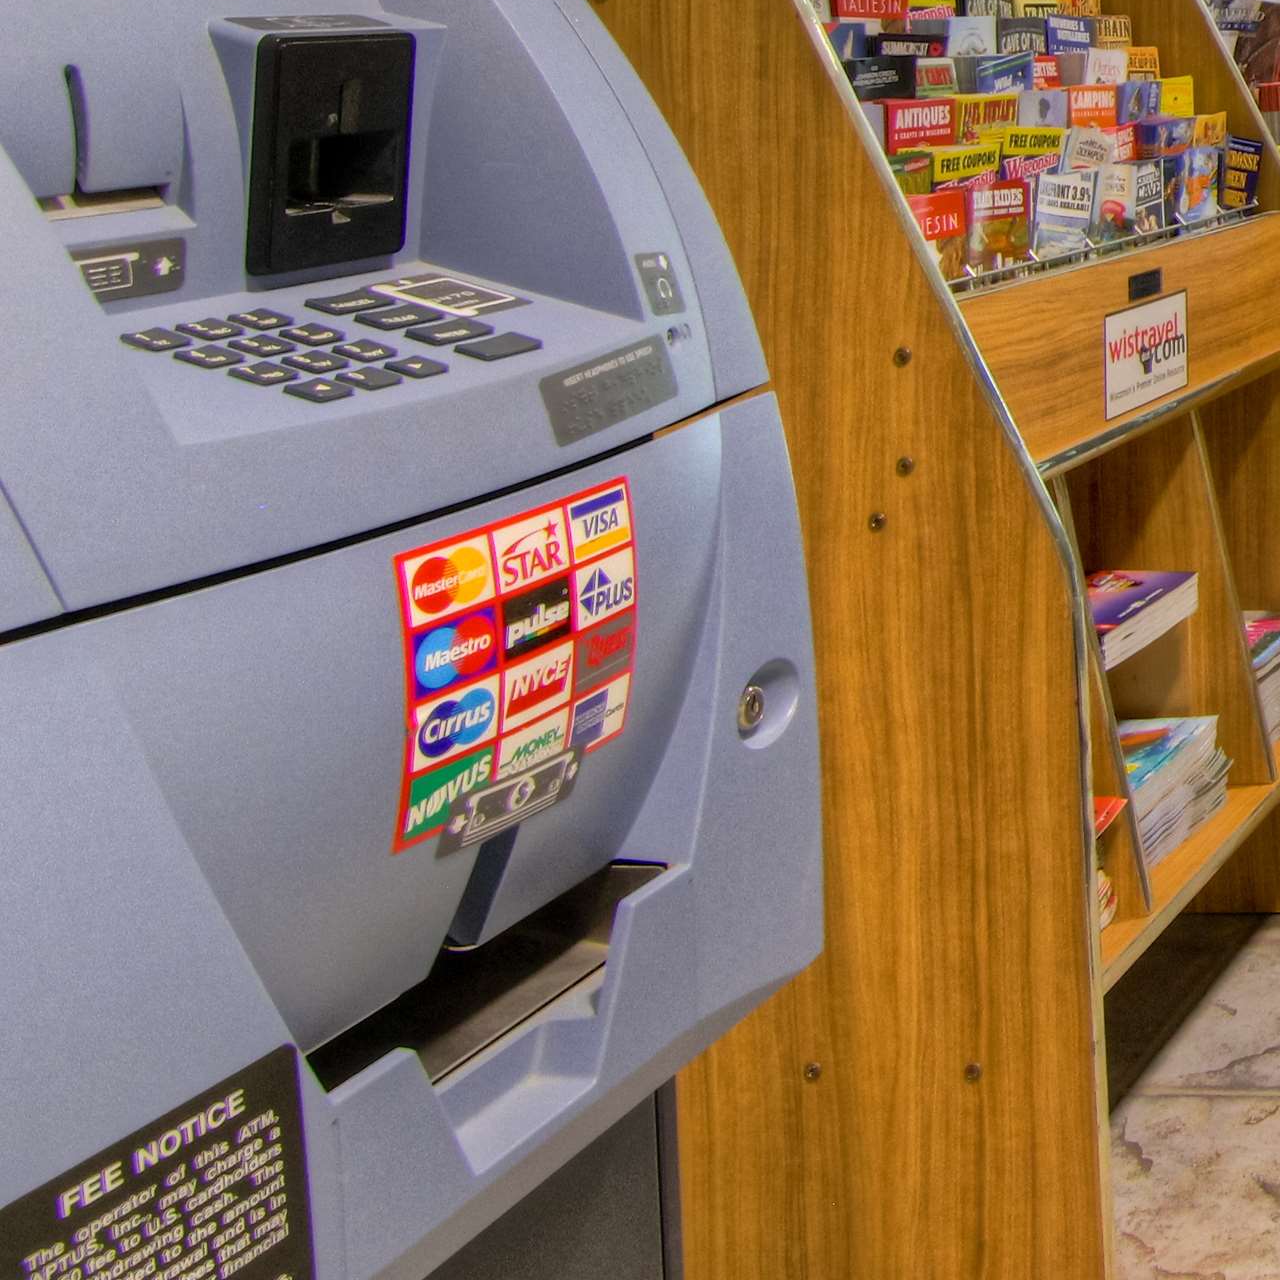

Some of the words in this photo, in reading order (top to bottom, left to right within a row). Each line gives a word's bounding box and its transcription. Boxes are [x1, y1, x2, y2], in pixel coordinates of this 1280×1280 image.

[1002, 34, 1021, 53] CAVE
[1021, 33, 1032, 51] OF
[1032, 32, 1045, 52] THE
[896, 105, 950, 128] ANTIQUES
[1072, 90, 1115, 109] CAMPING
[941, 158, 960, 174] FREE
[962, 150, 997, 170] COUPONS
[1010, 134, 1027, 148] FREE
[1029, 134, 1060, 148] COUPONS
[1006, 153, 1059, 180] Wisconsin
[921, 214, 959, 236] IESIN
[1109, 312, 1178, 364] wistravel
[582, 506, 619, 539] VISA
[413, 560, 487, 600] MasterCard
[502, 538, 566, 587] STAR
[595, 576, 634, 617] PLUS
[506, 598, 570, 649] pulse
[424, 632, 492, 673] Maestro
[512, 655, 571, 702] NYCE
[425, 699, 493, 743] Cirrus
[512, 725, 563, 761] MONEY
[57, 1161, 124, 1219] FEE
[133, 1088, 246, 1174] NOTICE
[158, 1178, 197, 1211] may
[204, 1137, 263, 1183] charge
[269, 1126, 281, 1142] a
[21, 1241, 65, 1272] The
[73, 1184, 157, 1243] operator
[164, 1163, 187, 1189] of
[193, 1141, 230, 1169] this
[235, 1109, 280, 1144] ATM,
[84, 1248, 116, 1275] fee
[117, 1234, 141, 1255] to
[143, 1207, 182, 1237] U.S.
[183, 1143, 283, 1212] cardholders
[190, 1191, 239, 1227] cash.
[251, 1160, 284, 1186] The
[160, 1244, 182, 1265] to
[186, 1221, 217, 1248] the
[221, 1175, 286, 1225] amount
[211, 1217, 245, 1249] and
[249, 1207, 266, 1224] is
[269, 1193, 287, 1212] in
[216, 1230, 251, 1264] that
[253, 1208, 288, 1239] may
[219, 1222, 289, 1280] financial
